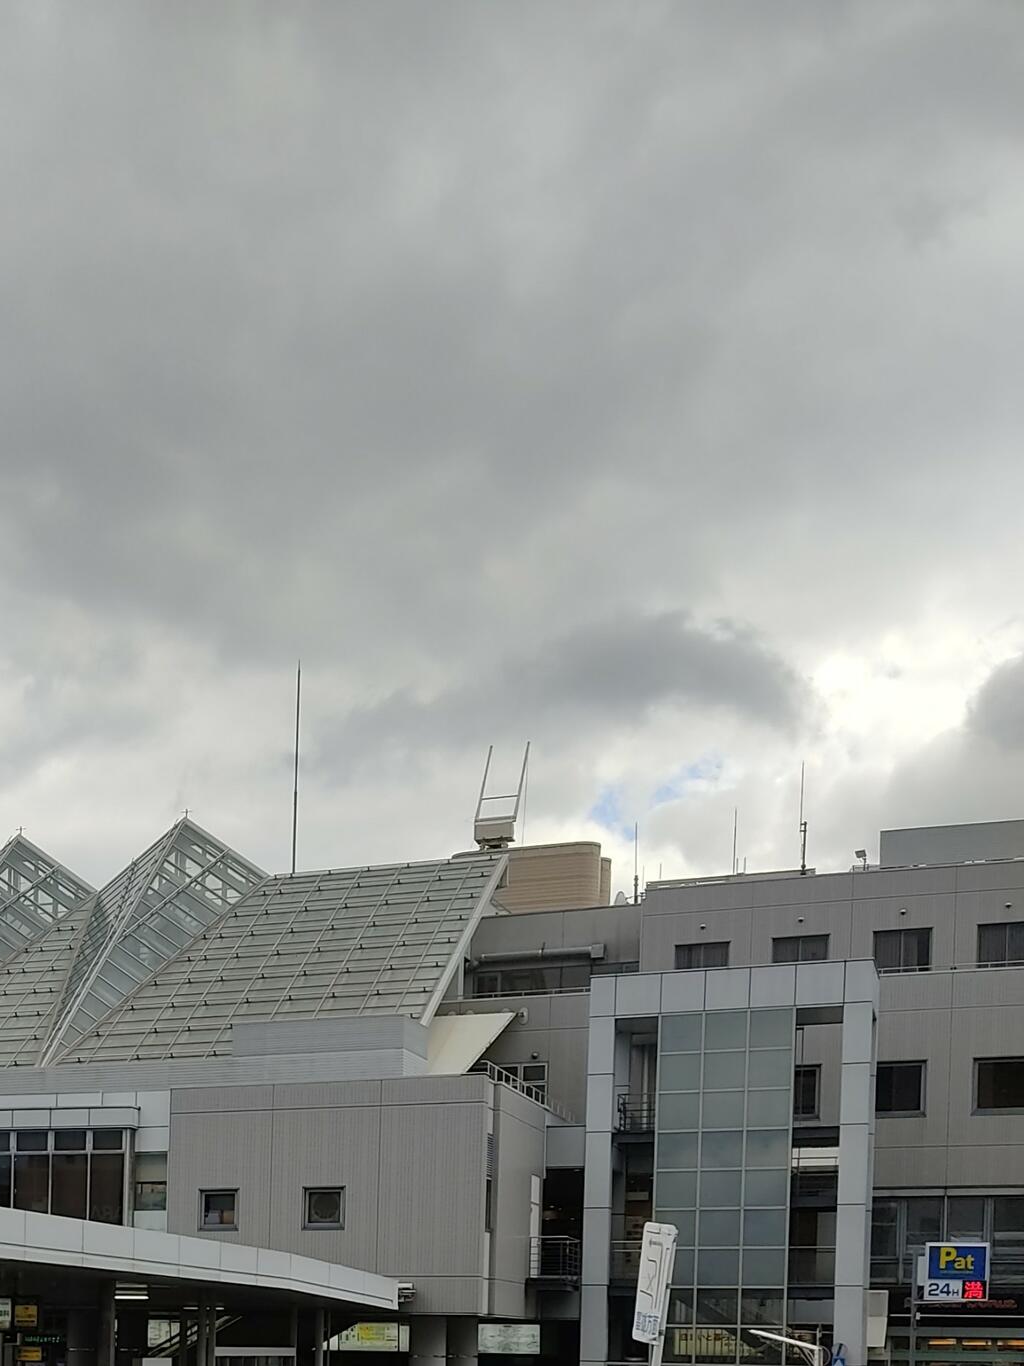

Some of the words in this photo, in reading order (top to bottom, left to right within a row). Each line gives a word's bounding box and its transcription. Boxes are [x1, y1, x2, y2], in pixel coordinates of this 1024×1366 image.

[939, 1247, 975, 1270] Pat
[928, 1283, 960, 1297] 24H
[964, 1281, 984, 1299] 満
